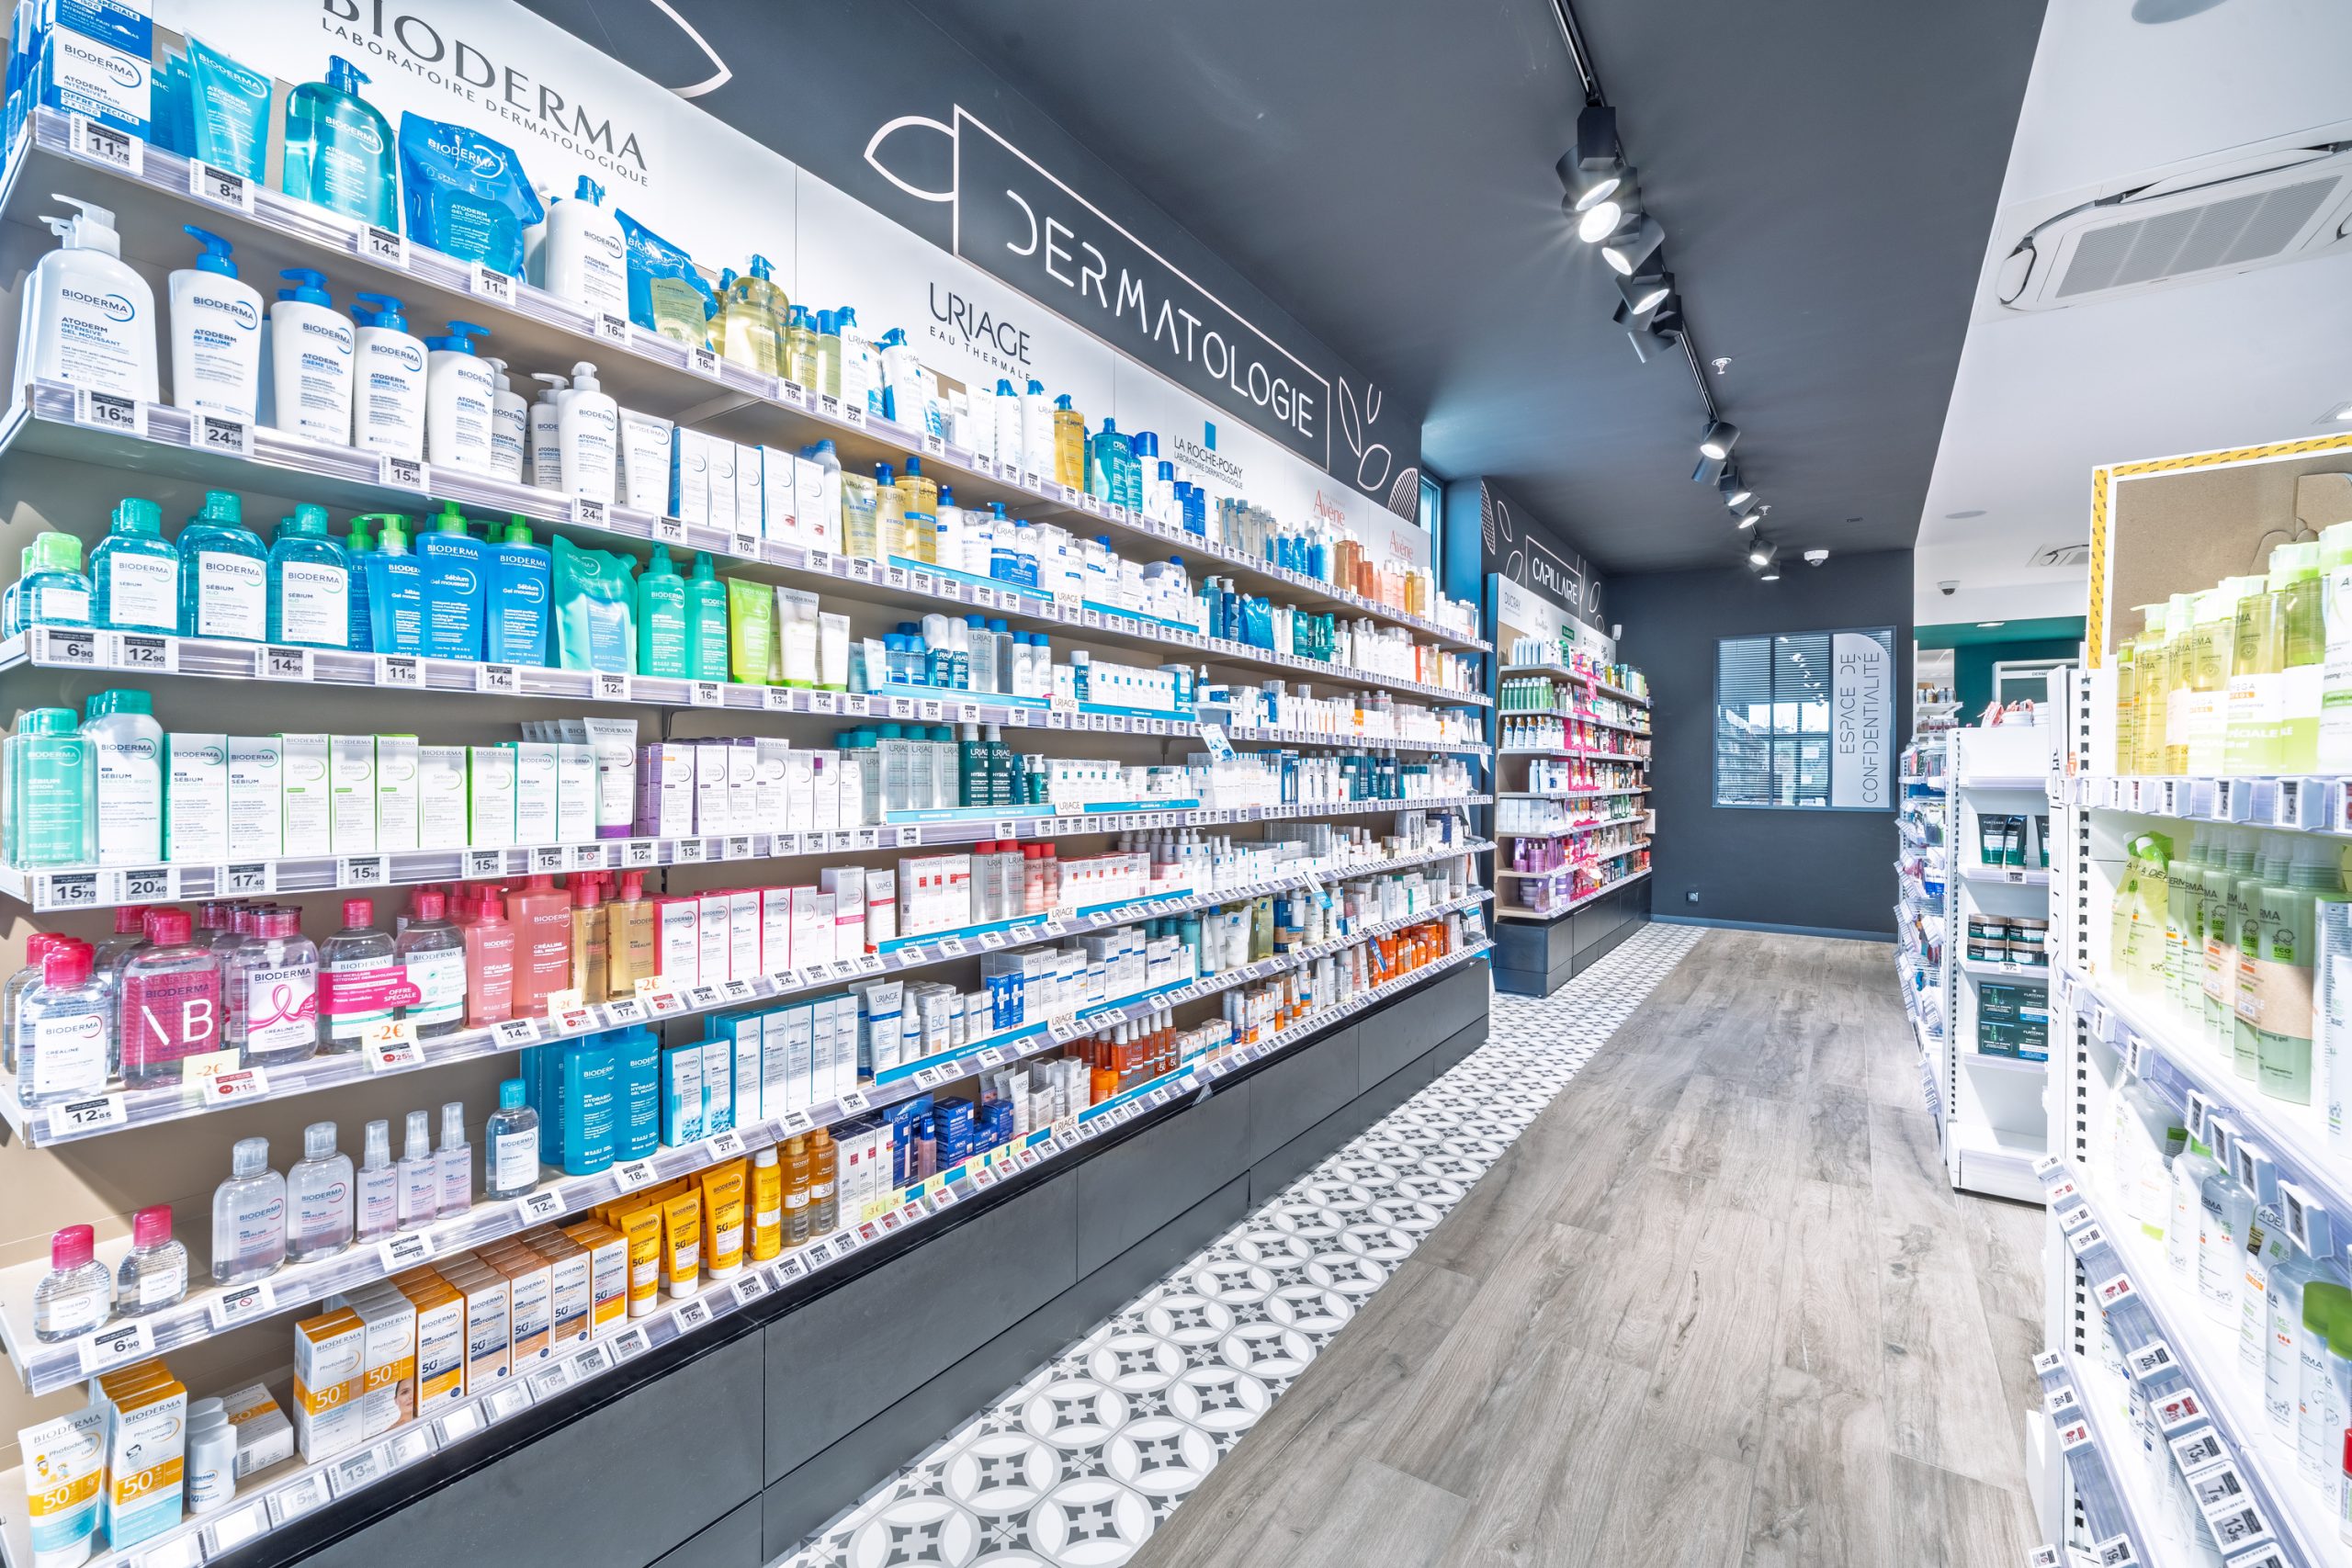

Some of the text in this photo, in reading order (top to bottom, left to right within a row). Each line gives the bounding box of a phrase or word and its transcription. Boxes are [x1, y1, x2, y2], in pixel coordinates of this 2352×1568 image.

[64, 44, 134, 79] BIODERMA
[198, 52, 260, 89] BIODERMA
[64, 75, 107, 95] ATODERM
[64, 81, 120, 105] INTENSIVE PAIN
[63, 92, 93, 107] OFFRE
[96, 103, 137, 123] SPÉCIALE
[322, 17, 648, 187] LABORATOIRE DERMATOLOGIQUE
[325, 117, 379, 144] BIODERMA
[428, 138, 496, 168] BIODERMA
[451, 203, 487, 218] ATODERM
[584, 231, 620, 252] BIODERMA
[62, 288, 128, 313] BIODERMA
[194, 296, 254, 321] BIODERMA
[1006, 189, 1314, 439] DERMATOLOGIE
[62, 317, 108, 333] ATODERM
[62, 322, 102, 337] INTENSIVE
[930, 282, 1032, 367] URIAGE
[62, 328, 120, 347] GEL MOUSSANT
[194, 329, 237, 344] ATODERM
[303, 323, 351, 345] BIODERMA
[204, 337, 232, 347] BAUME
[302, 353, 339, 367] ATODERM
[371, 344, 420, 364] BIODERMA
[930, 325, 1032, 383] EAU THERMALE
[370, 373, 405, 384] ATODERM
[458, 396, 486, 408] ATODERM
[579, 409, 616, 424] BIODERMA
[629, 423, 669, 438] BIODERMA
[579, 434, 606, 443] ATODERM
[1174, 435, 1243, 479] LA ROCHE-POSAY
[1174, 452, 1243, 490] LABORATOIRE DERMATOLOGIQUE
[1314, 490, 1345, 526] Avène
[427, 544, 479, 558] BIODERMA
[119, 562, 169, 575] BIODERMA
[500, 555, 547, 569] BIODERMA
[206, 562, 260, 578] BIODERMA
[445, 573, 469, 582] Sébium
[288, 572, 340, 586] BIODERMA
[444, 581, 469, 589] moussant
[1532, 558, 1577, 604] CAPILLAIRE
[206, 584, 234, 592] SÉBIUM
[517, 582, 539, 592] Sébium
[786, 594, 817, 605] BIODERMA
[1057, 592, 1078, 604] URIAGE
[1055, 697, 1076, 709] URIAGE
[1840, 654, 1856, 753] ESPACE DE
[593, 726, 633, 736] BIODERMA
[1858, 652, 1879, 803] CONFIDENTIALITÉ
[28, 750, 77, 760] BIODERMA
[101, 743, 153, 754] BIODERMA
[174, 751, 220, 760] BIODERMA
[422, 750, 462, 758] BIODERMA
[232, 753, 275, 761] BIODERMA
[1058, 801, 1080, 811] URIAGE
[534, 913, 570, 923] BIODERMA
[664, 915, 694, 924] BIODERMA
[702, 908, 726, 917] BIODERMA
[1051, 907, 1073, 919] URIAGE
[533, 941, 562, 951] CRÉALINE
[340, 958, 388, 970] BIODERMA
[413, 951, 457, 962] BIODERMA
[254, 968, 311, 982] BIODERMA
[146, 984, 209, 998] BIODERMA
[638, 977, 660, 991] -2€
[384, 992, 416, 1001] SPÉCIALE
[875, 992, 899, 1004] URIAGE
[1051, 1012, 1073, 1025] URIAGE
[46, 1021, 99, 1035] BIODERMA
[371, 1023, 404, 1041] -2€
[197, 1064, 223, 1077] -2€
[1055, 1116, 1076, 1134] URIAGE
[501, 1135, 534, 1148] BIODERMA
[713, 1178, 741, 1193] BIODERMA
[301, 1188, 343, 1202] BIODERMA
[240, 1203, 281, 1221] BIODERMA
[673, 1202, 696, 1217] BIODERMA
[629, 1218, 657, 1234] BIODERMA
[595, 1249, 623, 1265] BIODERMA
[555, 1263, 585, 1279] BIODERMA
[514, 1279, 547, 1294] BIODERMA
[470, 1293, 504, 1311] BIODERMA
[514, 1294, 547, 1310] PHOTODERM
[369, 1314, 413, 1332] BIODERMA
[421, 1312, 458, 1330] BIODERMA
[470, 1312, 504, 1328] PHOTODERM
[316, 1332, 361, 1353] BIODERMA
[372, 1336, 404, 1352] Photoderm
[422, 1331, 458, 1348] PHOTODERM
[320, 1354, 354, 1372] Photoderm
[125, 1399, 182, 1425] BIODERMA
[34, 1413, 103, 1445] BIODERMA
[134, 1419, 173, 1438] Photoderm
[48, 1437, 94, 1458] Photoderm
